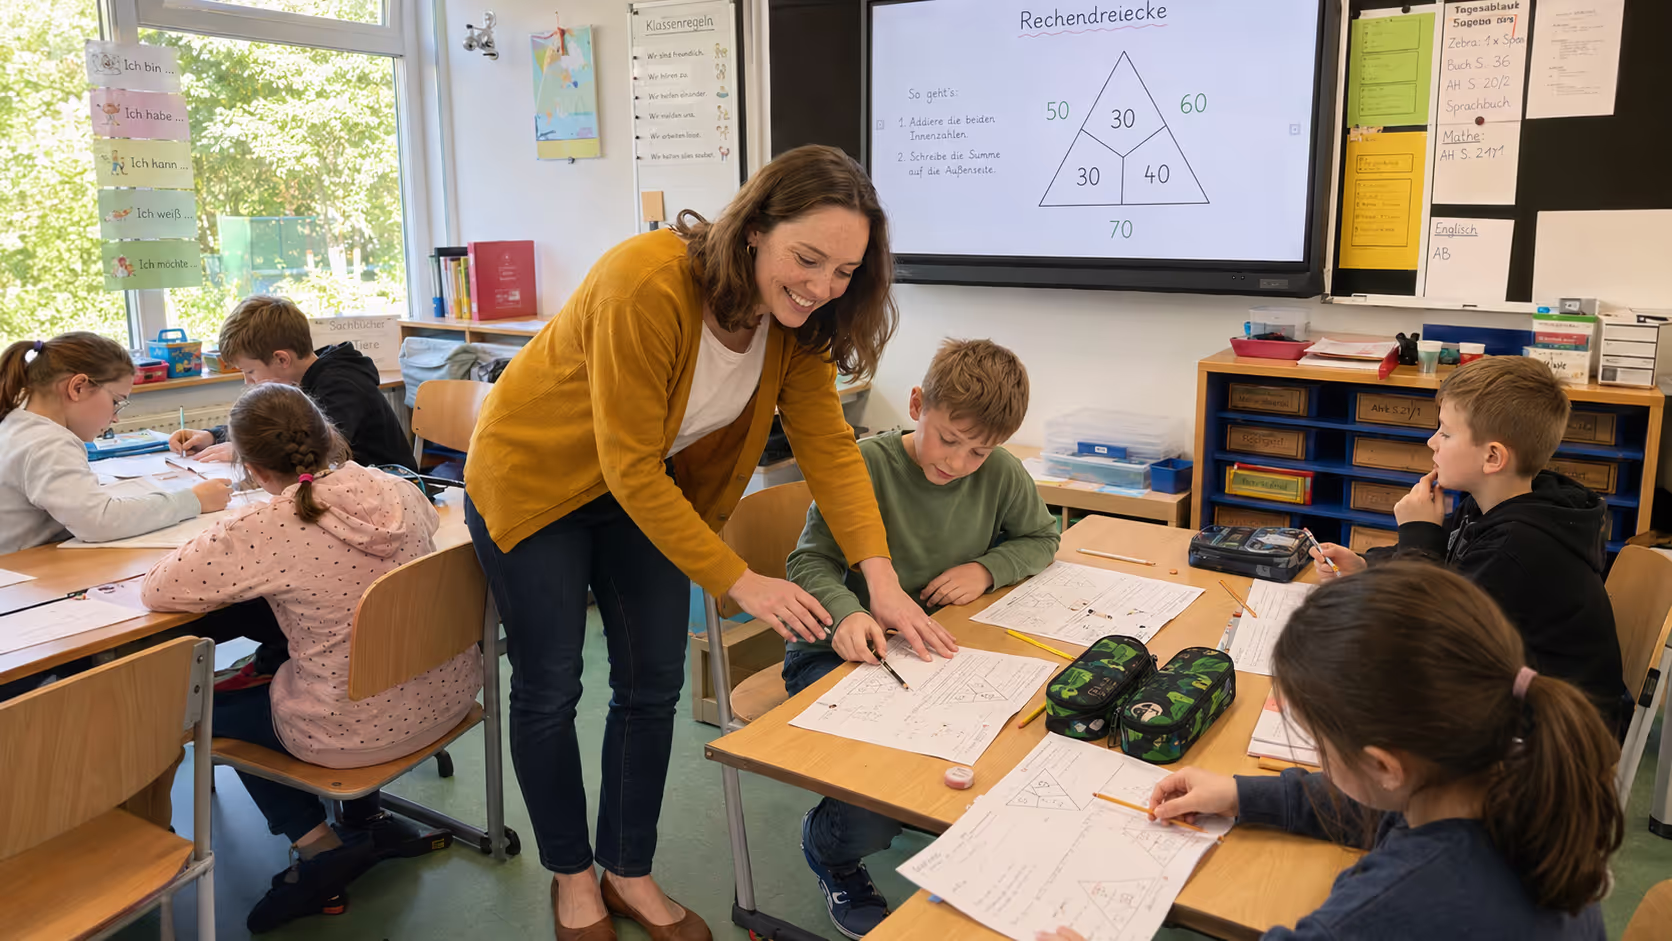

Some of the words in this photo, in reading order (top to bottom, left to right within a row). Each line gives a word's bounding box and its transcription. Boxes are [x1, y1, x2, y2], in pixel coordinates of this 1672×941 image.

[1020, 0, 1168, 30] Rechendreiecke
[646, 15, 714, 31] Klassenregeln
[1448, 36, 1480, 49] Zebra:
[647, 52, 658, 60] Wir
[1447, 58, 1472, 71] Buch
[1493, 54, 1511, 68] 36
[124, 59, 142, 71] Ich
[144, 61, 162, 73] bin
[1446, 79, 1461, 91] AH
[1483, 74, 1510, 90] 20/2
[908, 88, 921, 100] So
[926, 88, 959, 104] geht's:
[1180, 93, 1207, 114] 60
[1046, 101, 1069, 120] 50
[1446, 95, 1511, 117] Sprachbuch
[125, 107, 143, 119] Ich
[146, 109, 172, 121] habe
[898, 117, 907, 128] 1.
[909, 117, 943, 127] Addiere
[947, 116, 961, 125] die
[965, 114, 996, 124] beiden
[1110, 108, 1135, 129] 30
[910, 129, 969, 141] Innenzahlen.
[1442, 128, 1485, 143] Mathe:
[897, 152, 906, 162] 2.
[910, 151, 947, 162] Schreibe
[950, 151, 964, 160] die
[968, 149, 1001, 160] Summe
[1440, 149, 1455, 161] AH
[1460, 148, 1471, 160] S.
[130, 156, 149, 169] Ich
[151, 158, 177, 169] kann
[908, 166, 924, 179] auf
[927, 166, 940, 176] die
[945, 164, 996, 178] Außenseite.
[1076, 167, 1101, 186] 30
[1144, 164, 1170, 184] 40
[137, 208, 154, 219] Ich
[156, 208, 181, 220] weiß
[1109, 219, 1133, 239] 70
[1435, 222, 1478, 238] Englisch
[1433, 247, 1451, 260] AB
[139, 259, 155, 270] Ich
[157, 260, 188, 269] möchte
[329, 320, 385, 331] Sachbücher
[352, 340, 380, 350] Tiere
